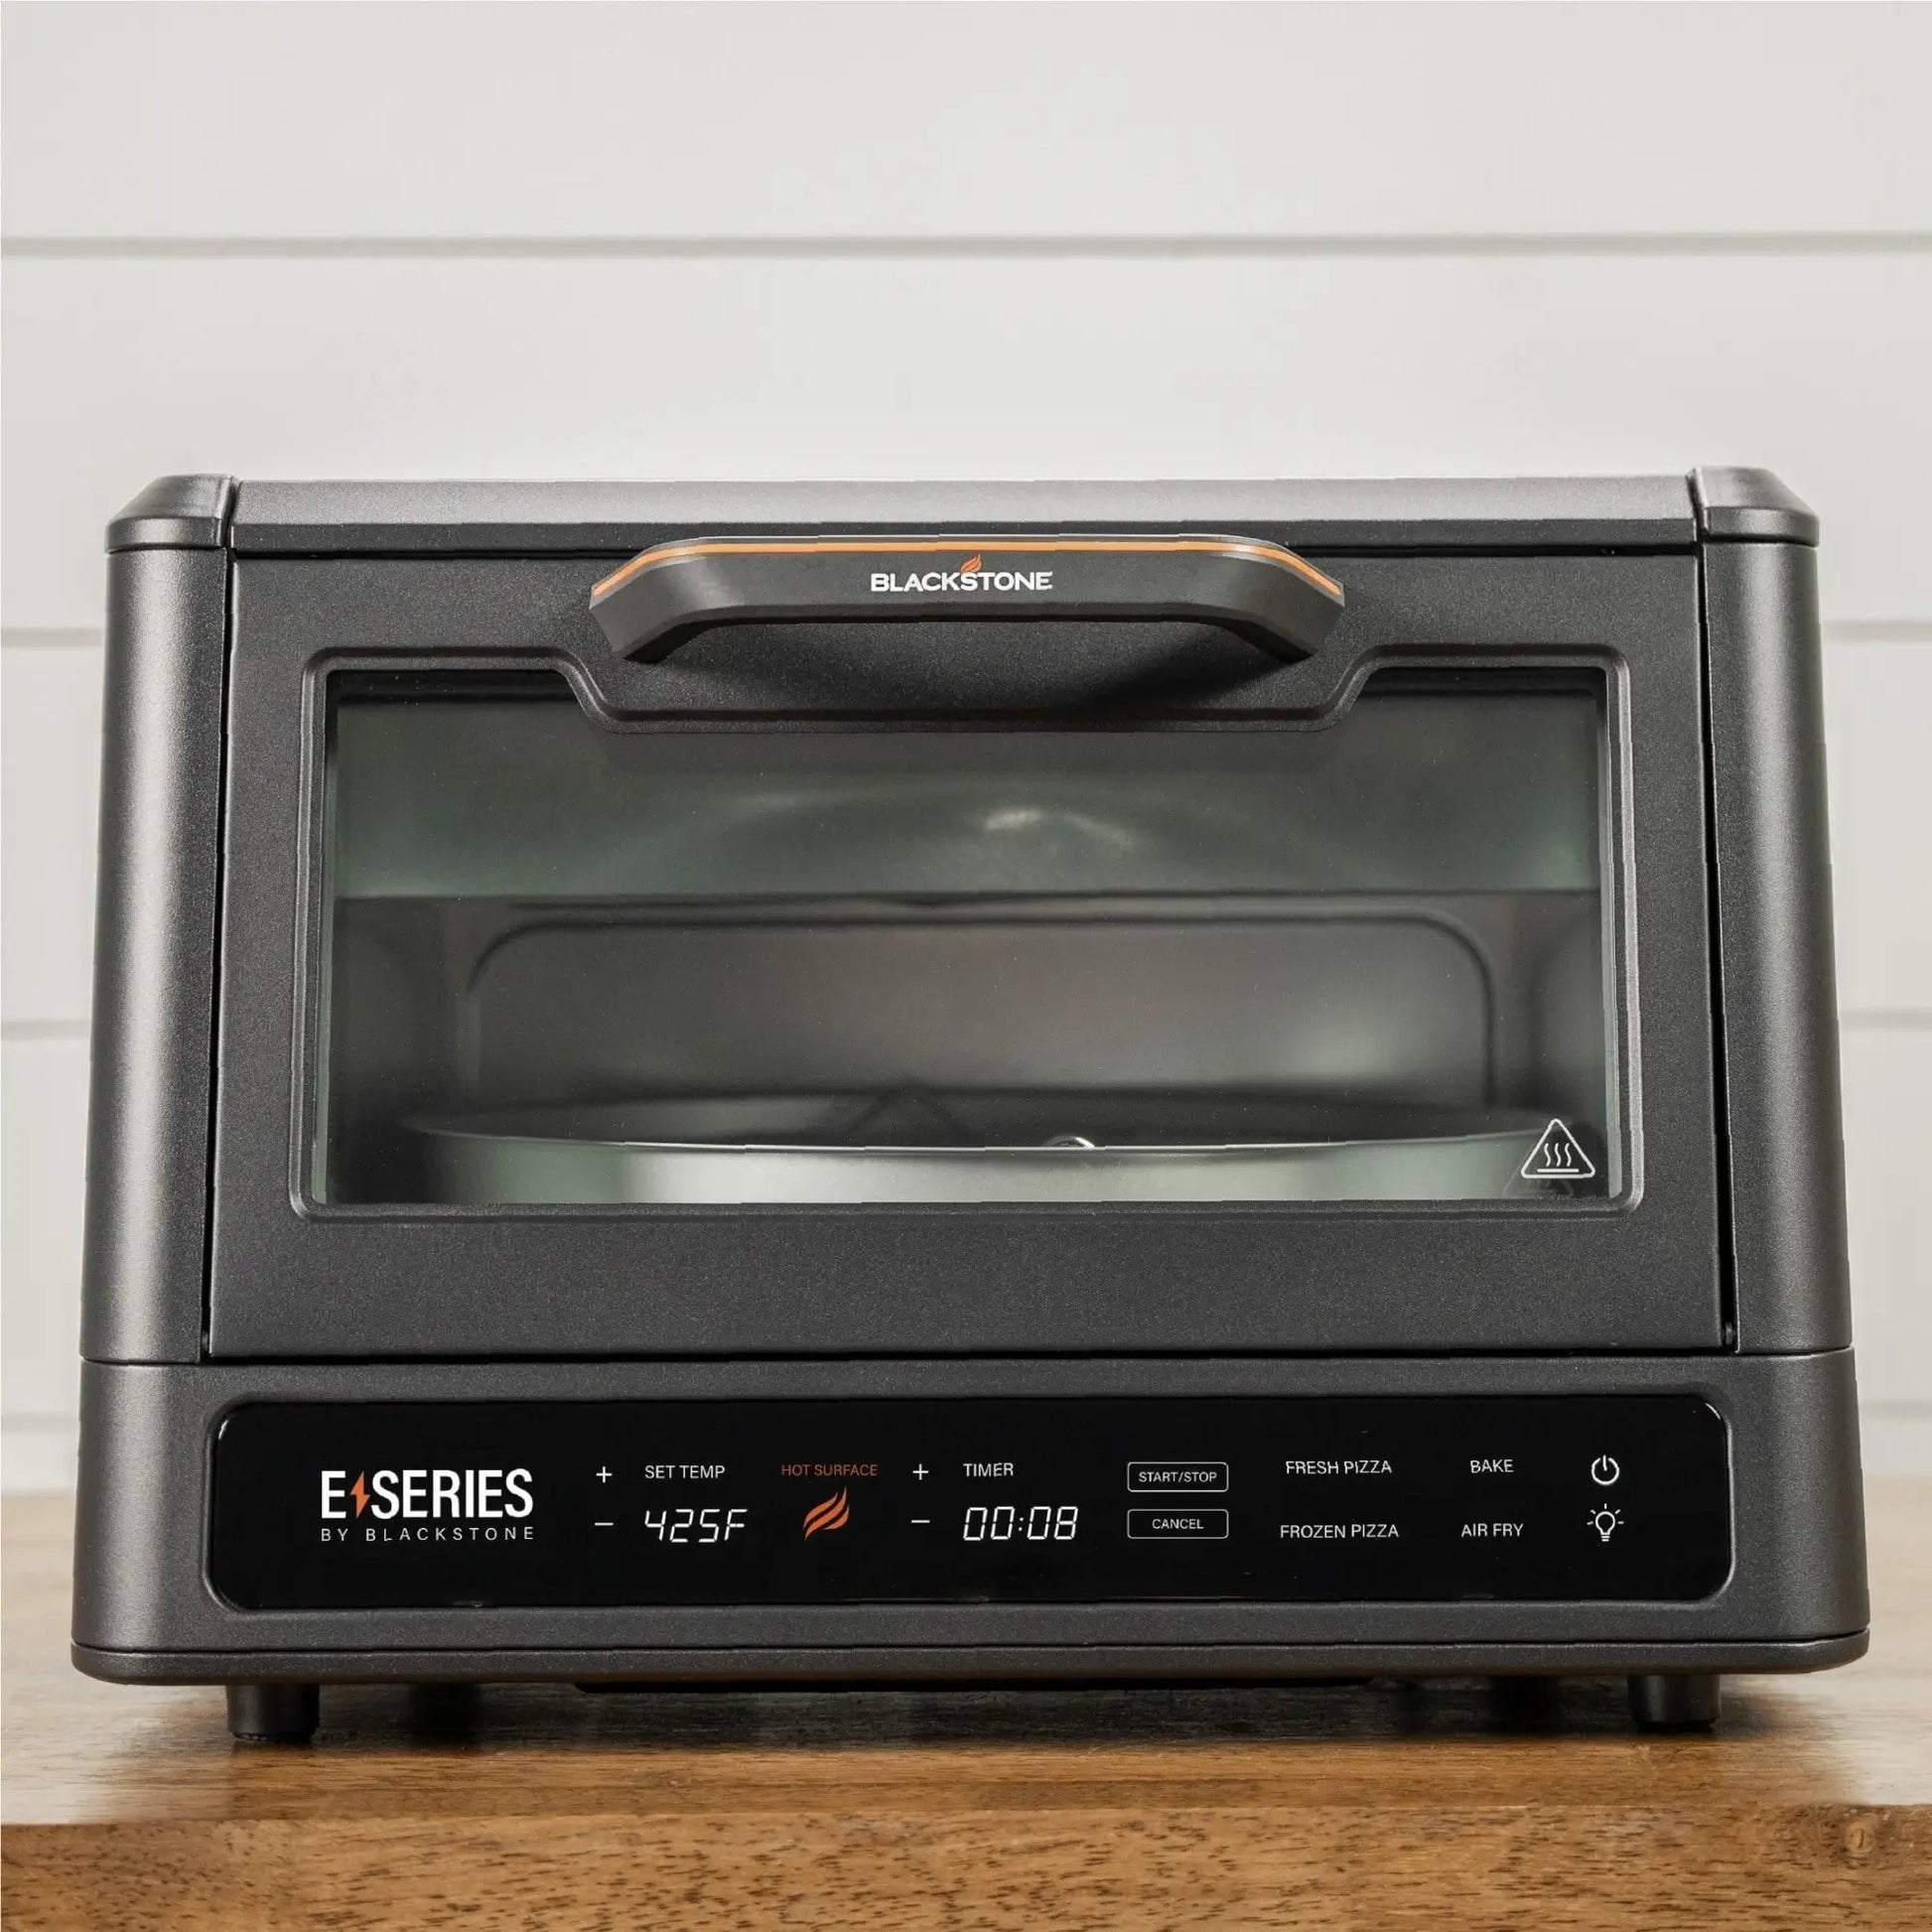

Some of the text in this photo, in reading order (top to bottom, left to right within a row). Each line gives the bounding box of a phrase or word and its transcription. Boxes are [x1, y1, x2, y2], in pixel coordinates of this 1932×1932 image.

[871, 571, 1053, 593] BLACKSTONE
[644, 1464, 726, 1479] SET TEMP
[781, 1463, 879, 1476] HOT SURFACE
[962, 1461, 1015, 1477] TIMER
[1285, 1459, 1393, 1475] FRESH PIZZA
[1469, 1458, 1514, 1474] BAKE
[1138, 1470, 1218, 1483] START/STOP
[643, 1508, 749, 1544] 425F
[962, 1505, 1079, 1542] 00:08
[1152, 1518, 1204, 1530] CANCEL
[1280, 1523, 1400, 1539] FROZEN PIZZA
[1460, 1522, 1524, 1538] AIR FRY
[321, 1526, 534, 1542] BY BLACKSTONE
